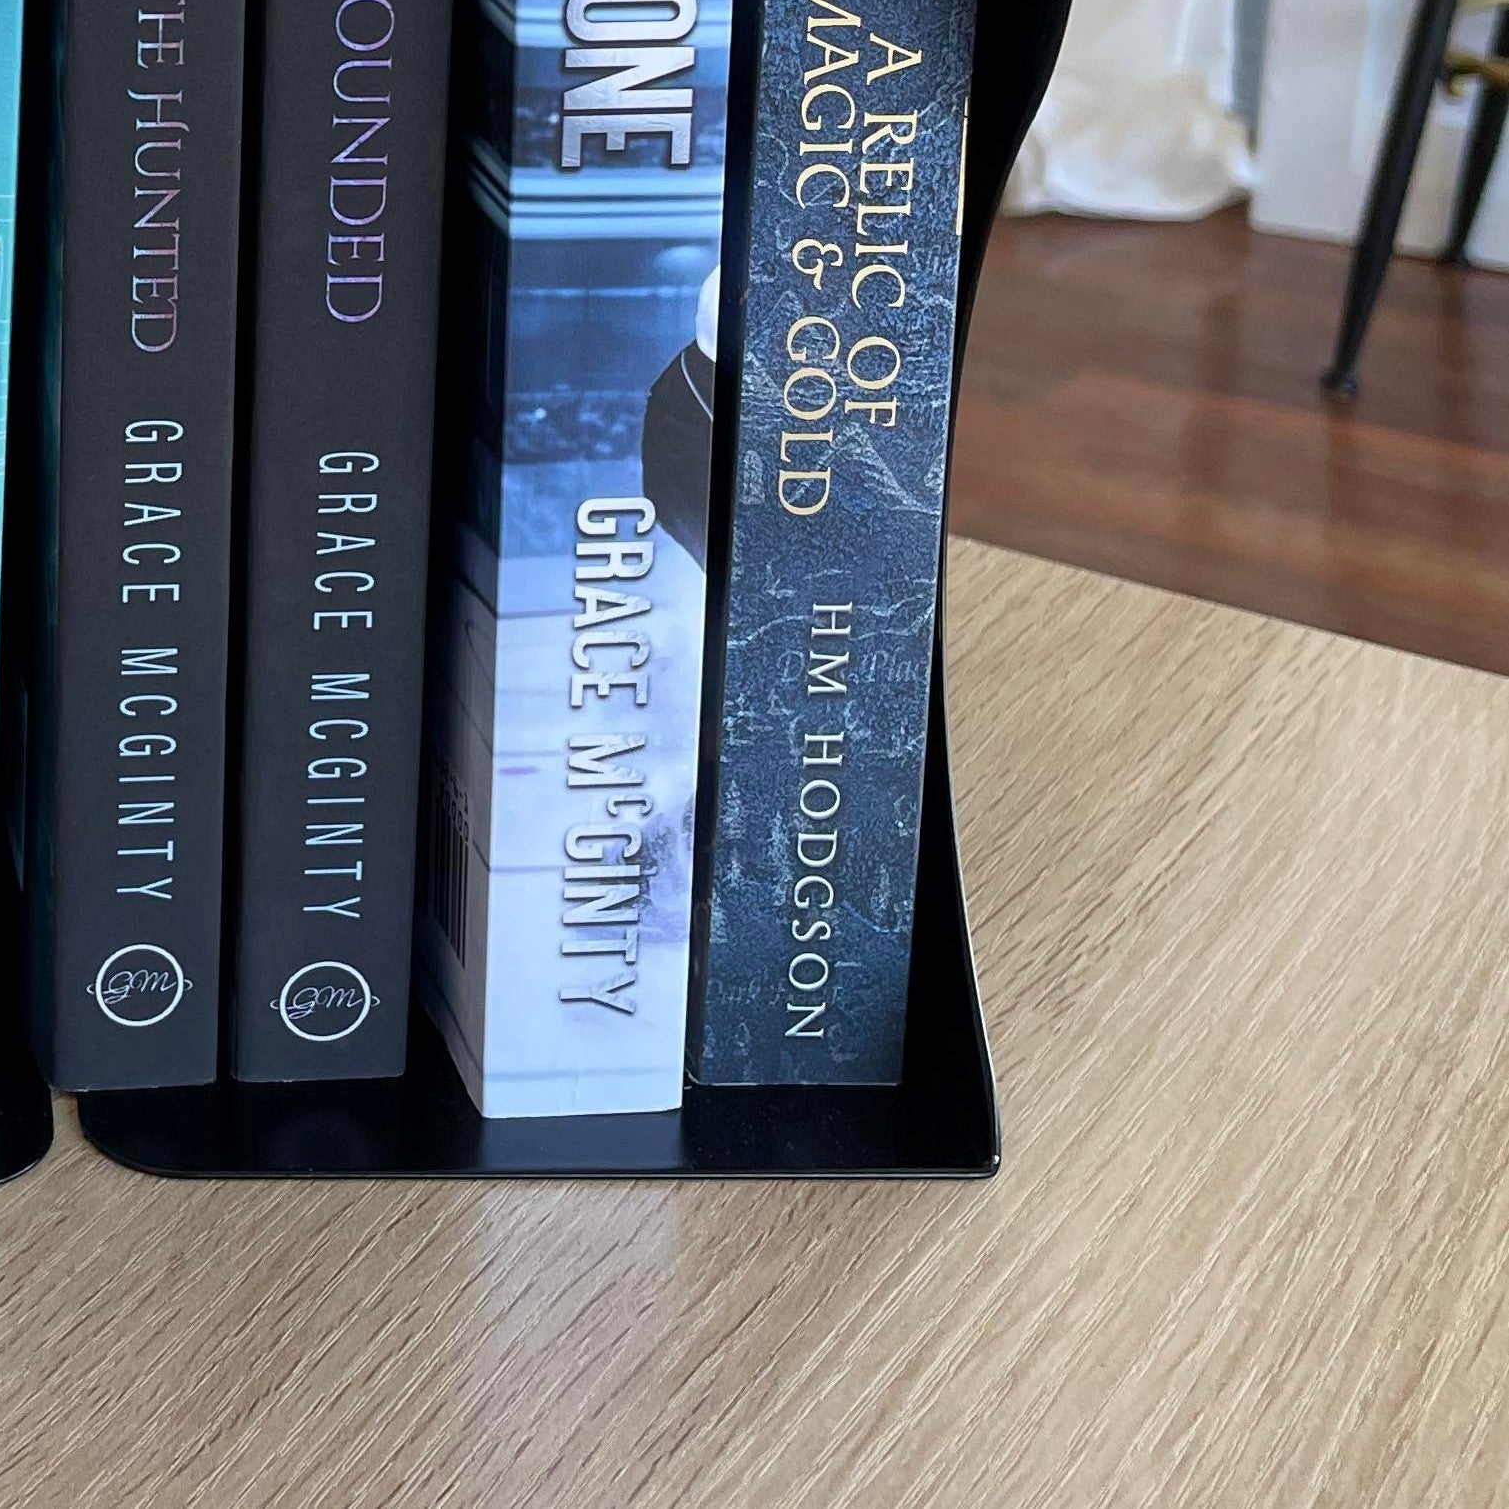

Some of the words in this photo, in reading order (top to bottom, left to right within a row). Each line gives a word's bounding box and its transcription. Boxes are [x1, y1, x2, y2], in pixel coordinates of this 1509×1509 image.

[865, 33, 923, 85] A
[126, 89, 189, 353] HUNTED
[792, 237, 844, 292] &
[852, 110, 919, 308] RELIC
[778, 316, 842, 516] GOLD
[844, 336, 903, 428] OF
[122, 419, 184, 603] GRACE
[313, 450, 380, 631] GRACE
[569, 496, 655, 709] GRACE
[806, 602, 854, 696] HM
[116, 647, 180, 900] MCGINTY
[303, 672, 371, 918] MCGINTY
[784, 732, 845, 1040] HODGSON
